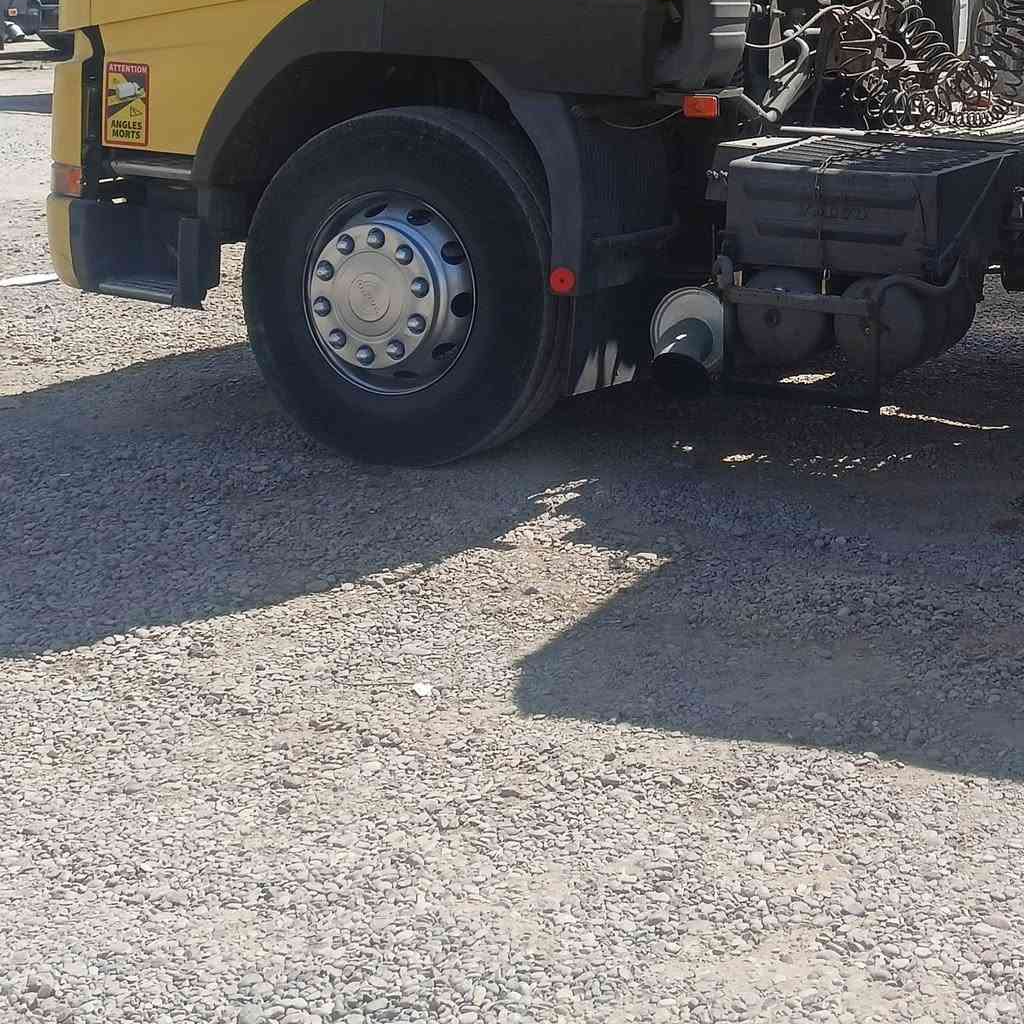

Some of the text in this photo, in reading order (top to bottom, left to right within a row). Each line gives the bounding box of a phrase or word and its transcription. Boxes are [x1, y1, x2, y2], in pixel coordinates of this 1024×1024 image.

[108, 63, 148, 74] ATTENTION
[111, 119, 143, 130] ANGLES
[112, 129, 141, 139] MORTS
